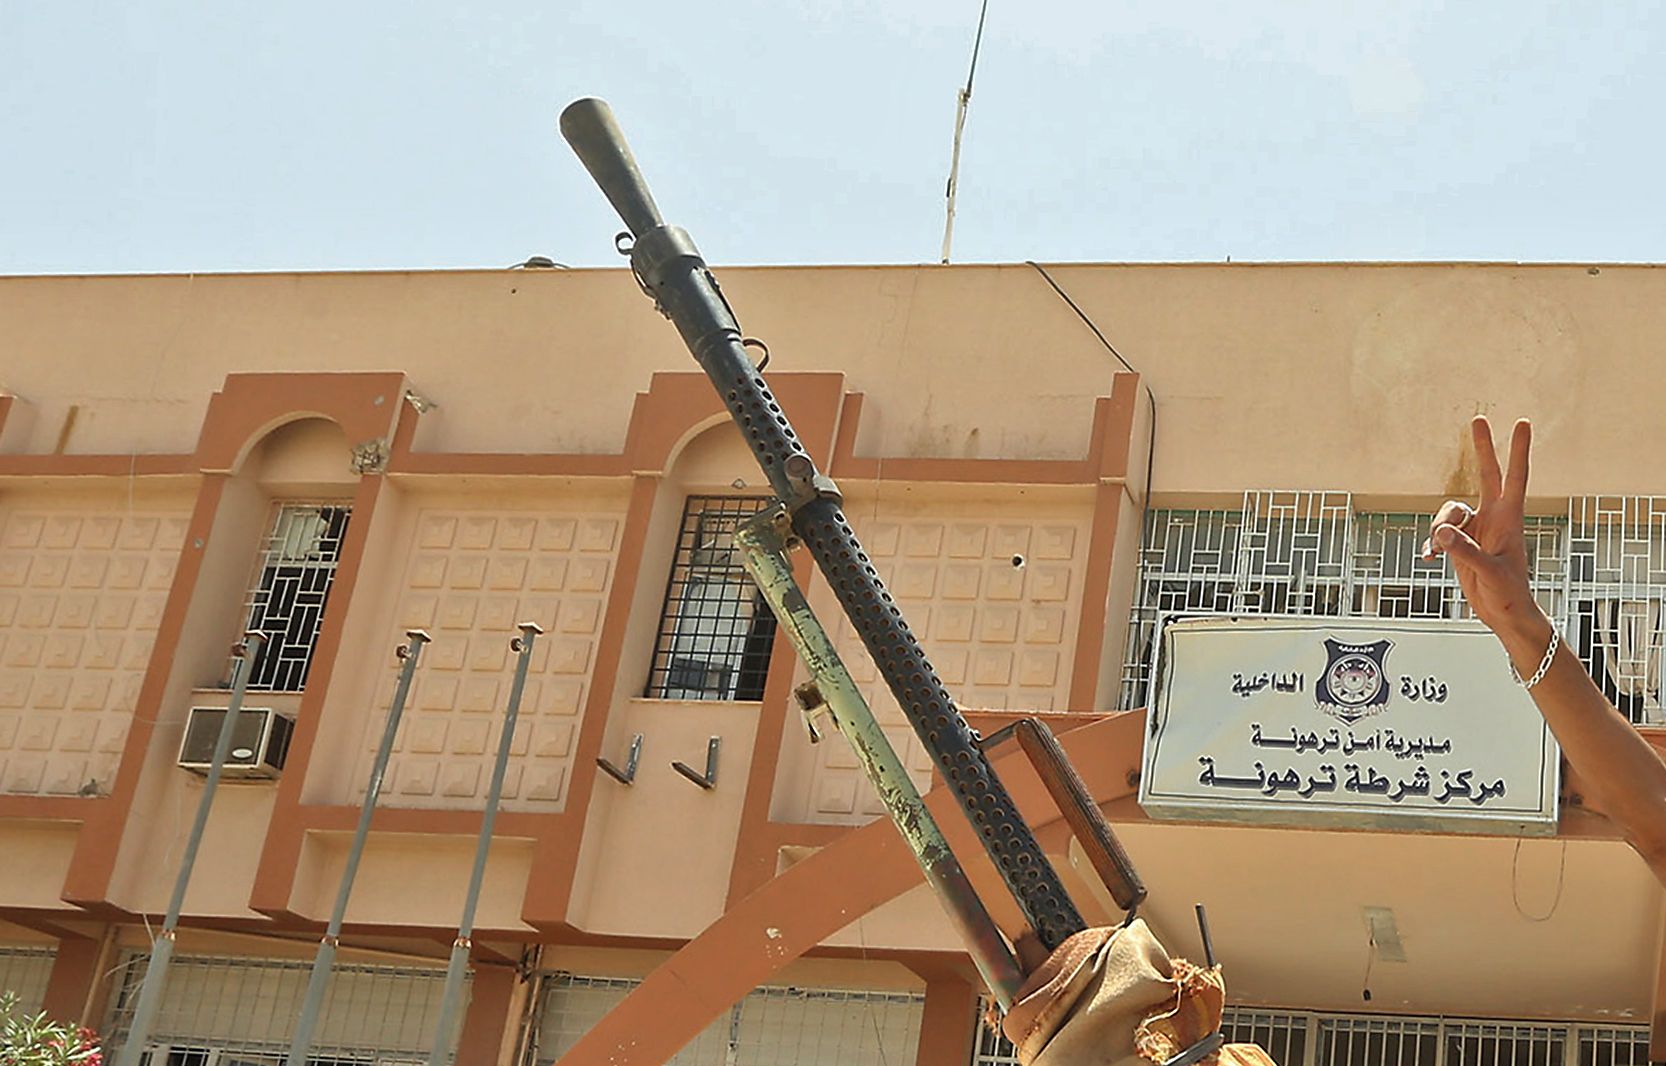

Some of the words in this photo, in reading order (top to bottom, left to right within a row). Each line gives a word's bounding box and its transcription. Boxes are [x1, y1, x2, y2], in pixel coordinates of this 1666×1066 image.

[1232, 672, 1305, 698] الداخلية
[1399, 676, 1448, 703] وزارة
[1251, 724, 1340, 756] ترهونة
[1385, 728, 1452, 761] مديرية
[1198, 755, 1338, 798] ترهونة
[1344, 763, 1431, 803] شرطة
[1434, 769, 1507, 807] مركز
